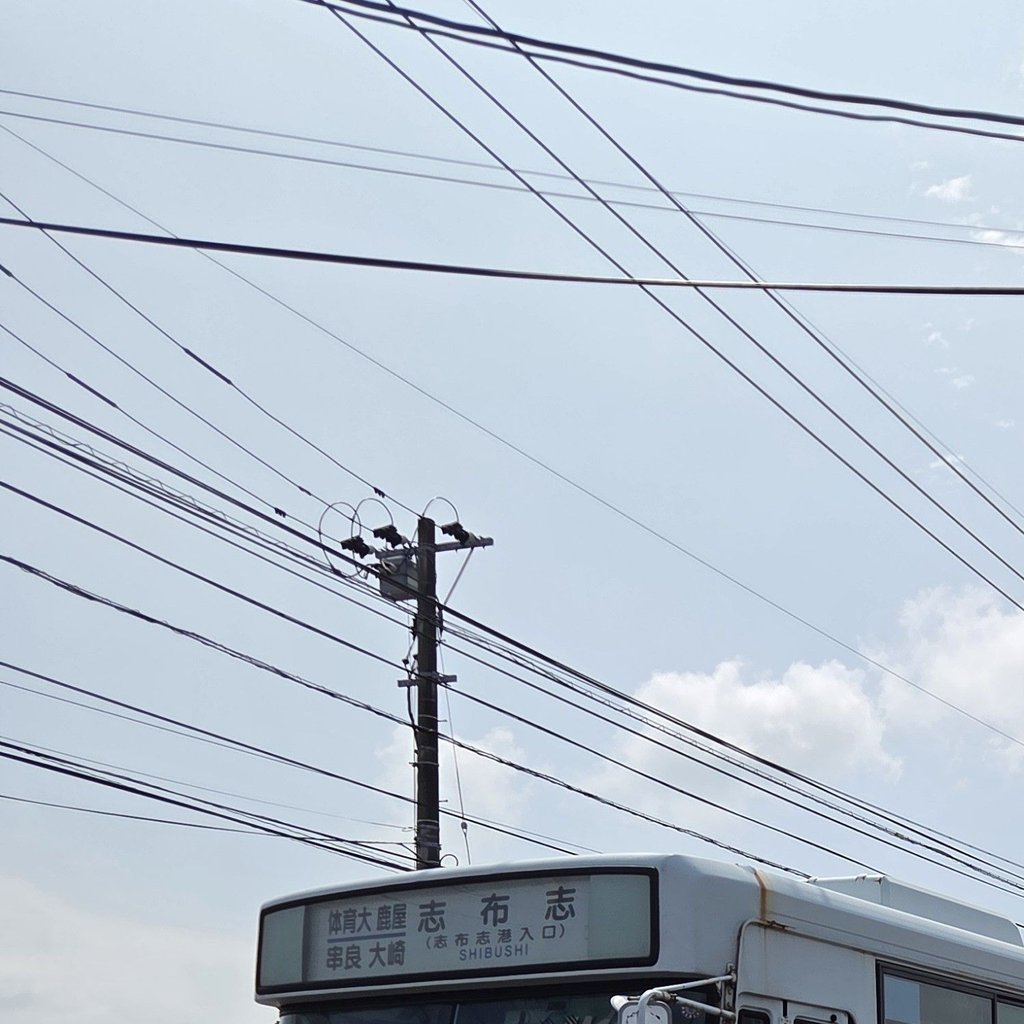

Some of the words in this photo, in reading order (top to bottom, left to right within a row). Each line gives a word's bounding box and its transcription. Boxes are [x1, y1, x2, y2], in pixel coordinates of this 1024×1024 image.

[328, 906, 372, 935] 体育大
[376, 903, 407, 931] 鹿屋
[418, 885, 577, 933] 志布志
[326, 943, 362, 971] 串良
[368, 940, 406, 968] 大崎
[459, 943, 529, 962] SHIBUSHI
